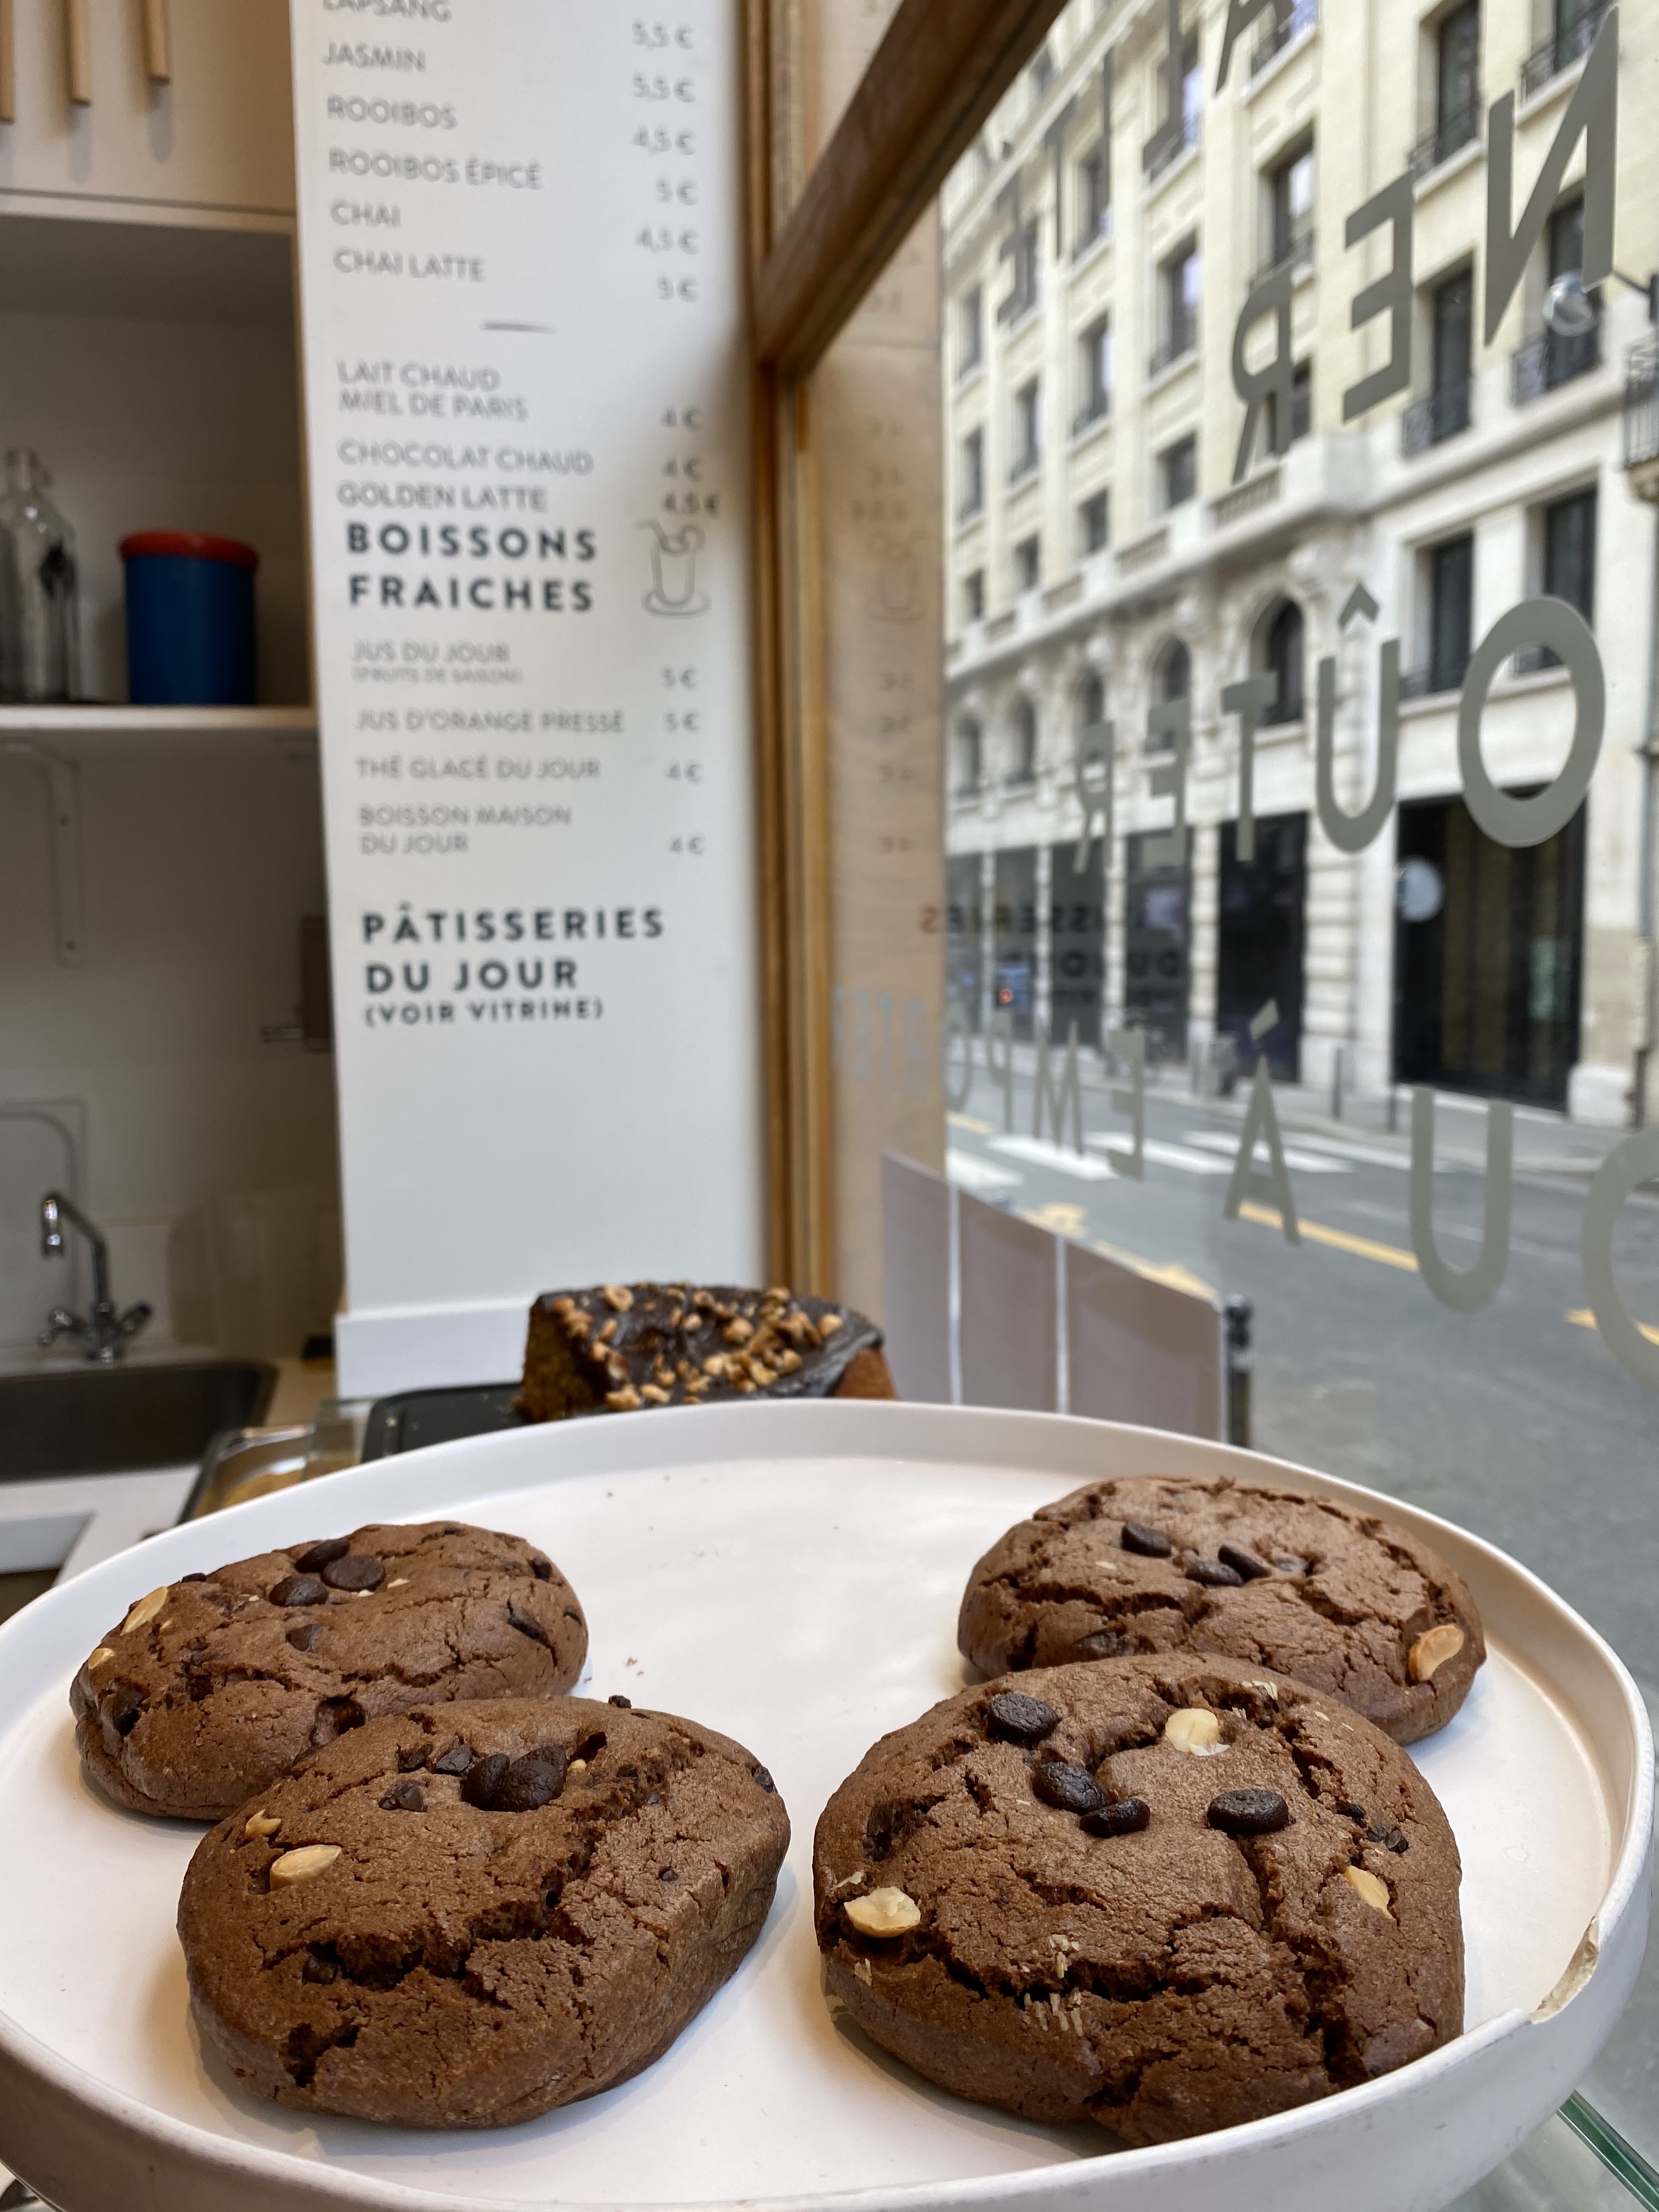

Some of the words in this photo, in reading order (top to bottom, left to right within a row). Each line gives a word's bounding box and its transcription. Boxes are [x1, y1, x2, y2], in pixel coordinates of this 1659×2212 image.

[323, 42, 424, 71] JASMIN
[328, 95, 456, 129] ROOIBOS
[330, 148, 459, 182] ROOIBOS
[466, 155, 542, 189] ÉPICÉ
[330, 200, 399, 227] CHAI
[334, 247, 402, 274] CHAI
[410, 255, 484, 281] LATTE
[338, 360, 393, 386] LAIT
[400, 362, 500, 391] CHAUD
[340, 389, 402, 414] MIEL
[409, 390, 446, 417] DE
[453, 394, 528, 421] PARIS
[338, 439, 489, 469] CHOCOLAT
[495, 447, 592, 475] CHAUD
[337, 482, 455, 509] GOLDEN
[462, 486, 546, 512] LATTE
[347, 522, 595, 561] BOISSONS
[349, 574, 591, 612] FRAICHES
[351, 639, 397, 664] JUS
[401, 639, 439, 664] DU
[444, 642, 509, 663] JOUR
[354, 708, 400, 732] JUS
[406, 709, 532, 733] D'ORANGE
[355, 753, 403, 778] THÉ
[409, 755, 488, 780] GLACÉ
[494, 756, 532, 781] DU
[538, 758, 600, 779] JOUR
[359, 805, 469, 826] BOISSON
[476, 805, 571, 826] MAISON
[358, 832, 398, 855] DU
[403, 833, 468, 854] JOUR
[362, 903, 663, 943] PÂTISSERIES
[366, 962, 429, 994] DU
[454, 959, 576, 991] JOUR
